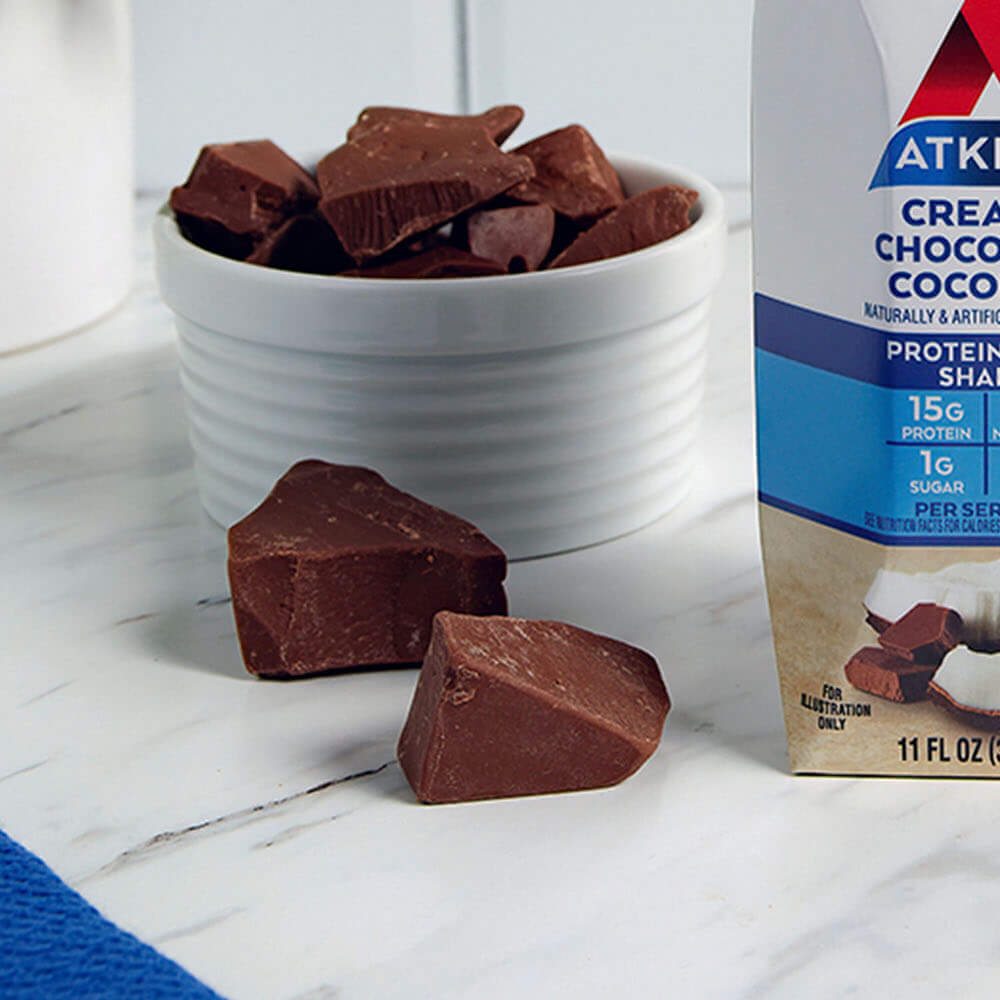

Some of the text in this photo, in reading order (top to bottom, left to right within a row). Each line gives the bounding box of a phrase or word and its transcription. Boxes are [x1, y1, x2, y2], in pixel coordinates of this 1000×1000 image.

[864, 302, 935, 324] NATURALLY
[939, 308, 948, 324] &
[908, 396, 964, 421] 15G
[902, 426, 971, 441] PROTEIN
[920, 450, 953, 476] 1G
[910, 481, 964, 494] SUGAR
[915, 502, 957, 517] PER
[918, 519, 943, 533] FACTS
[944, 519, 959, 533] FOR
[961, 519, 1000, 533] CALORIES
[822, 684, 842, 701] FOR
[801, 693, 871, 717] ILLUSTRATION
[818, 716, 846, 730] ONLY
[898, 737, 919, 762] 11
[927, 737, 950, 762] FL
[957, 737, 982, 763] OZ
